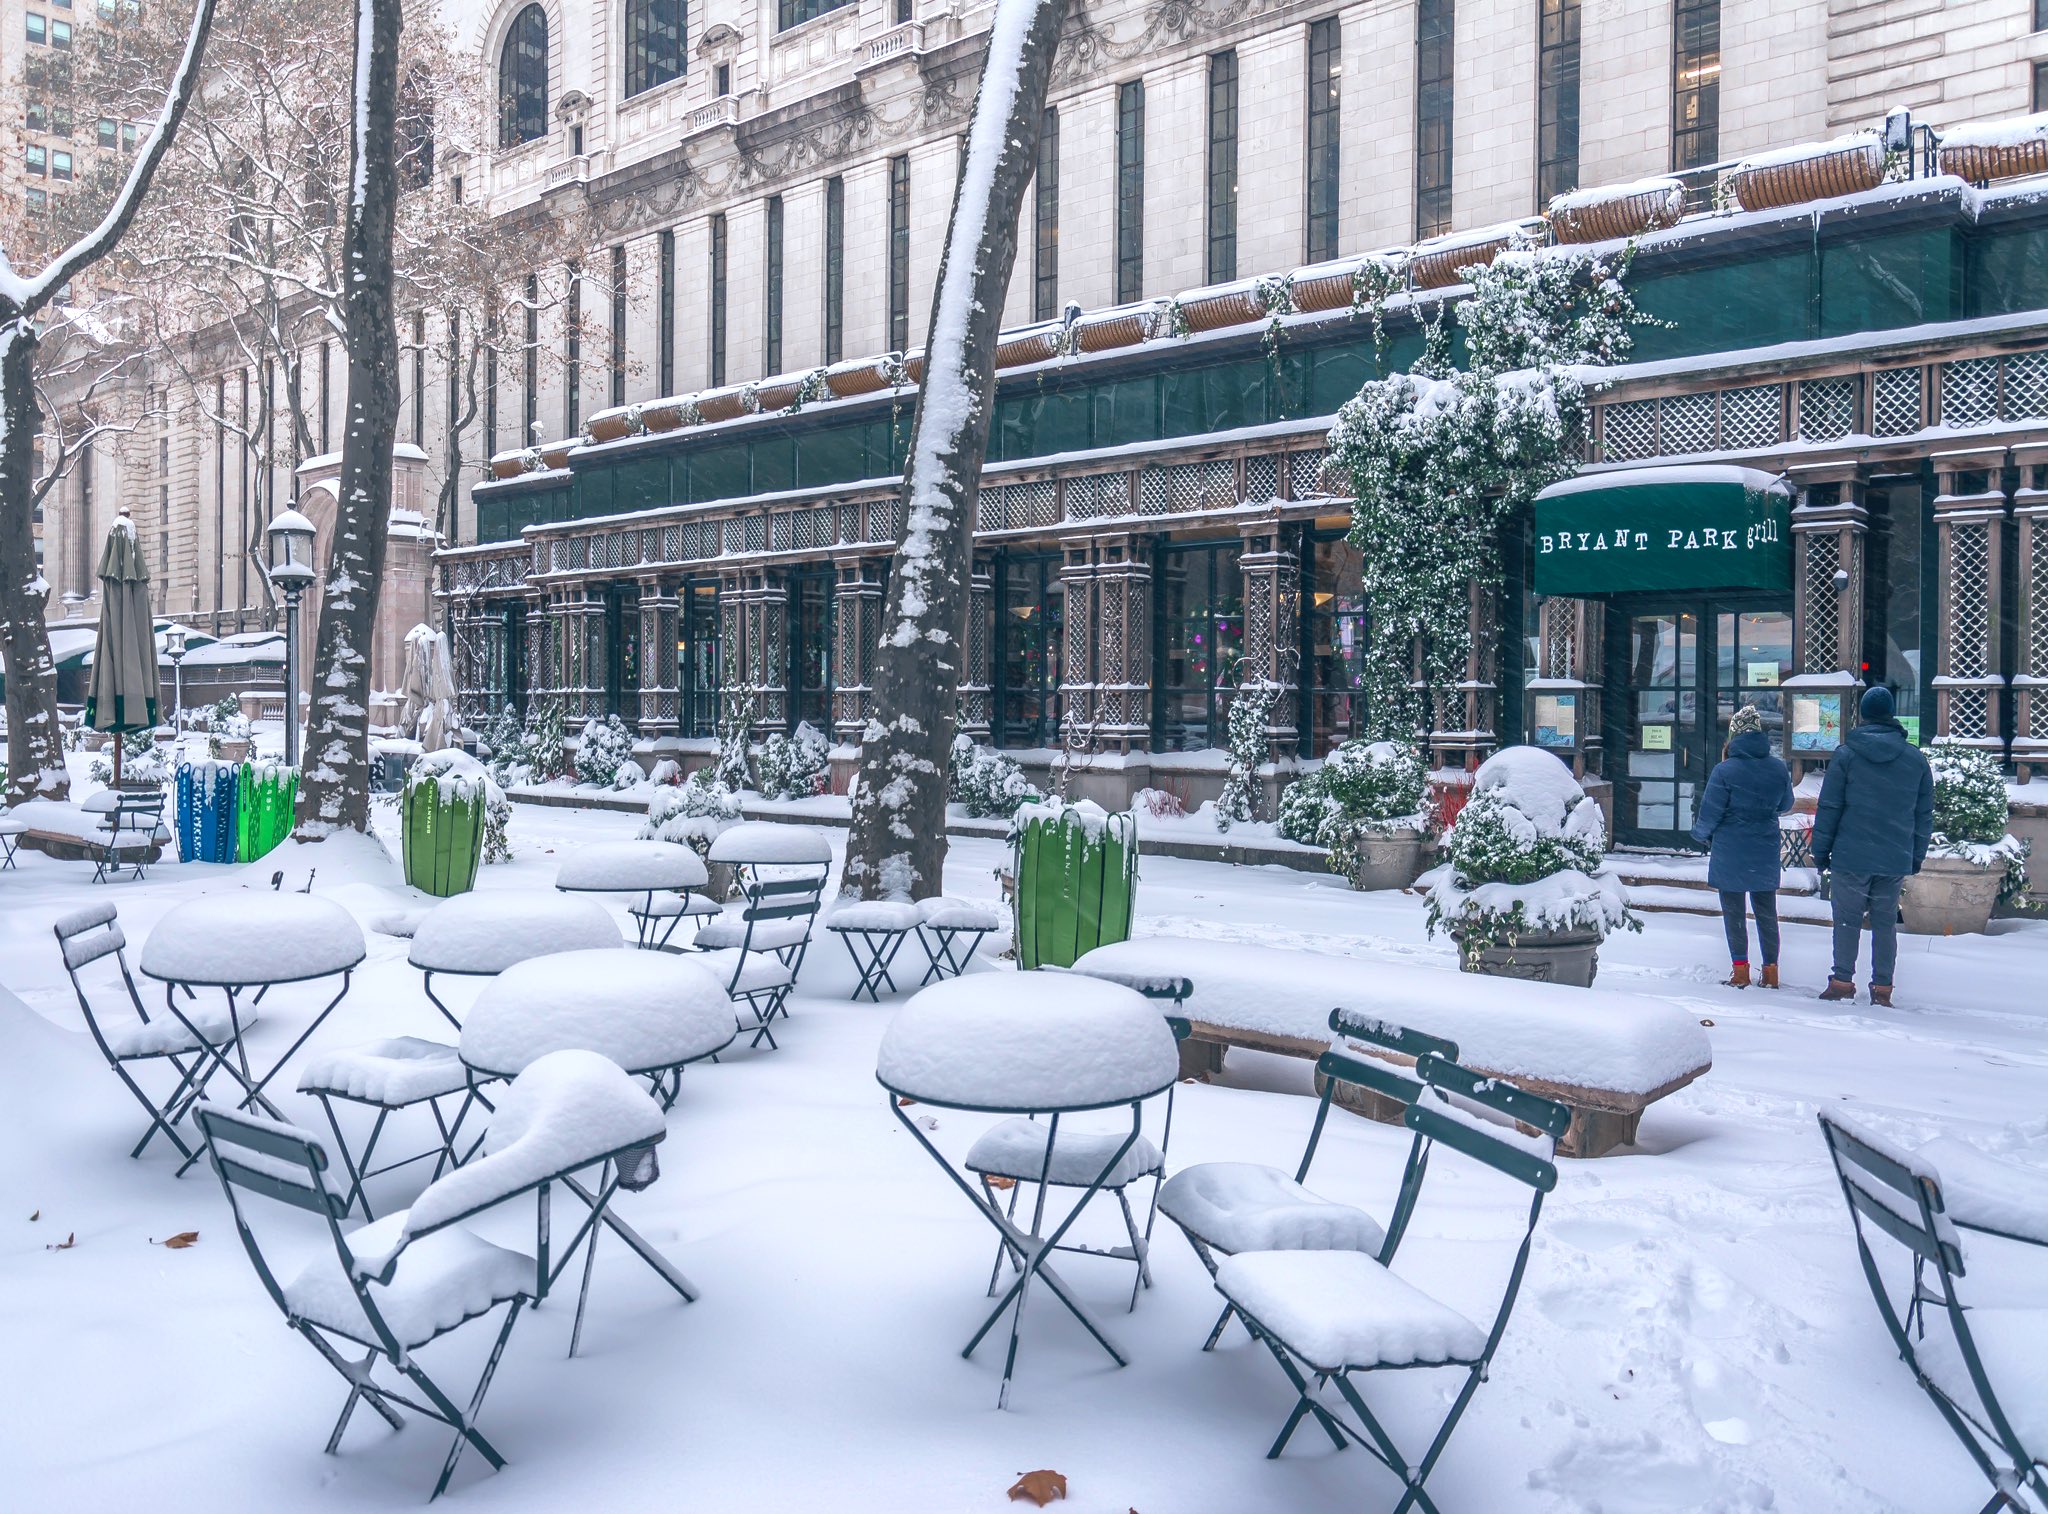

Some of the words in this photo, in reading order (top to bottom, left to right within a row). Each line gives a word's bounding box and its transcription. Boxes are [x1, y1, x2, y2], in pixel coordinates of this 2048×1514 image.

[1540, 529, 1649, 554] BRYANT
[1667, 528, 1738, 550] PARK
[1747, 518, 1779, 550] grill
